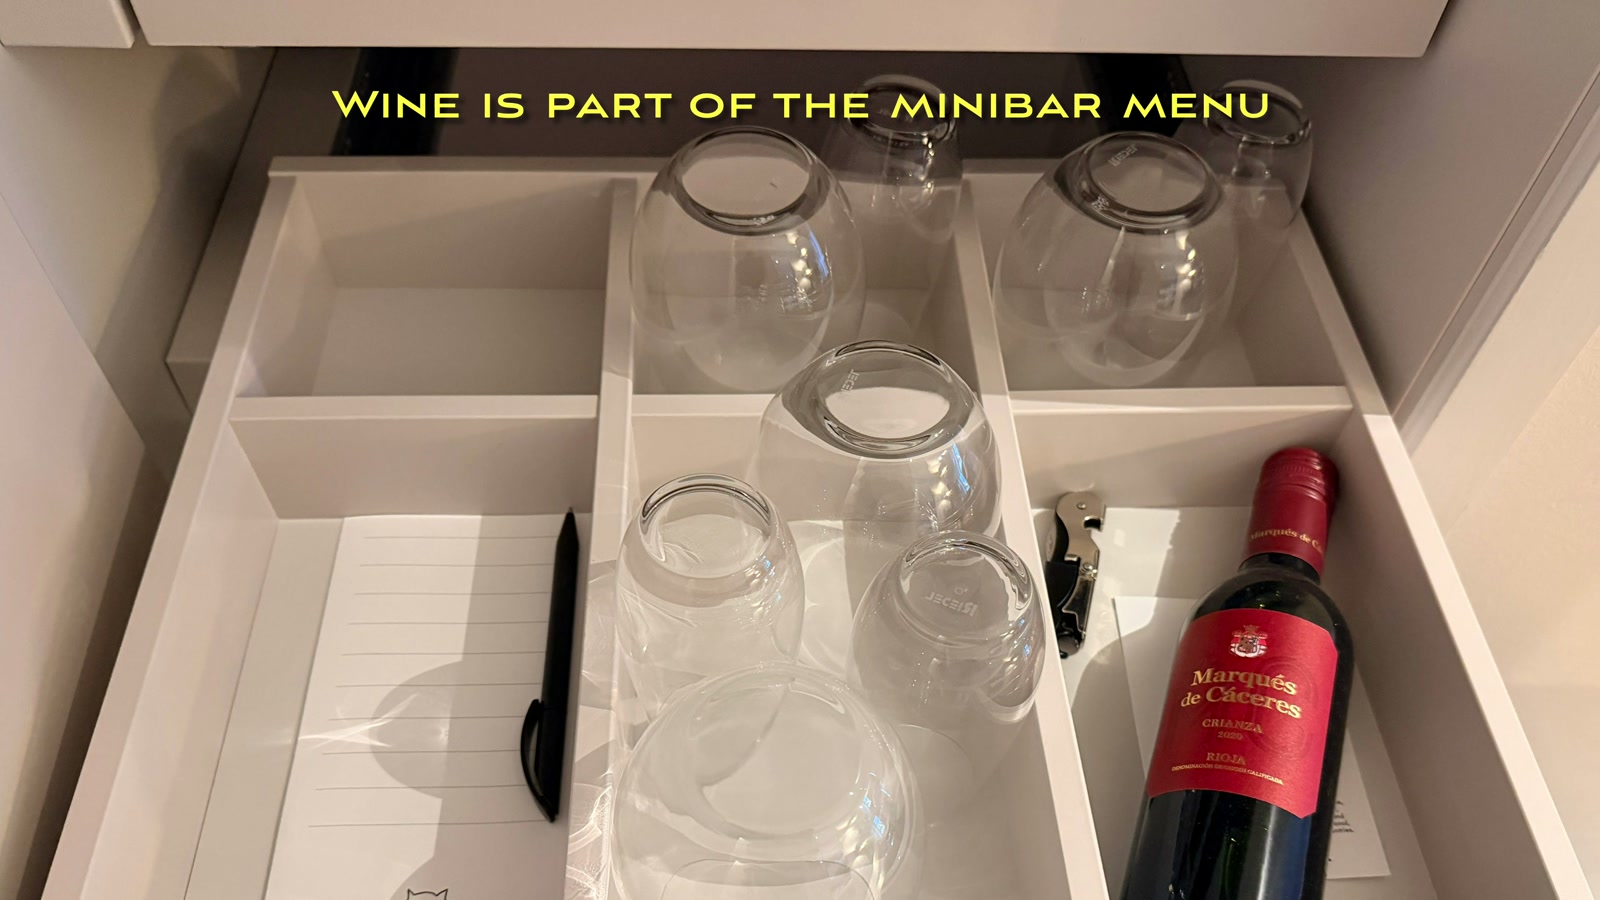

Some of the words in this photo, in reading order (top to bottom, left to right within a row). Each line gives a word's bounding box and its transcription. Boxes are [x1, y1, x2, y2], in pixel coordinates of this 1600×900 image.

[1300, 533, 1311, 544] de
[1190, 667, 1298, 696] Marqués
[1180, 691, 1201, 708] de
[1205, 685, 1302, 719] Cáceres
[1202, 718, 1264, 735] CRIANZA
[1217, 731, 1244, 741] 2020
[1206, 752, 1246, 766] RIOJA
